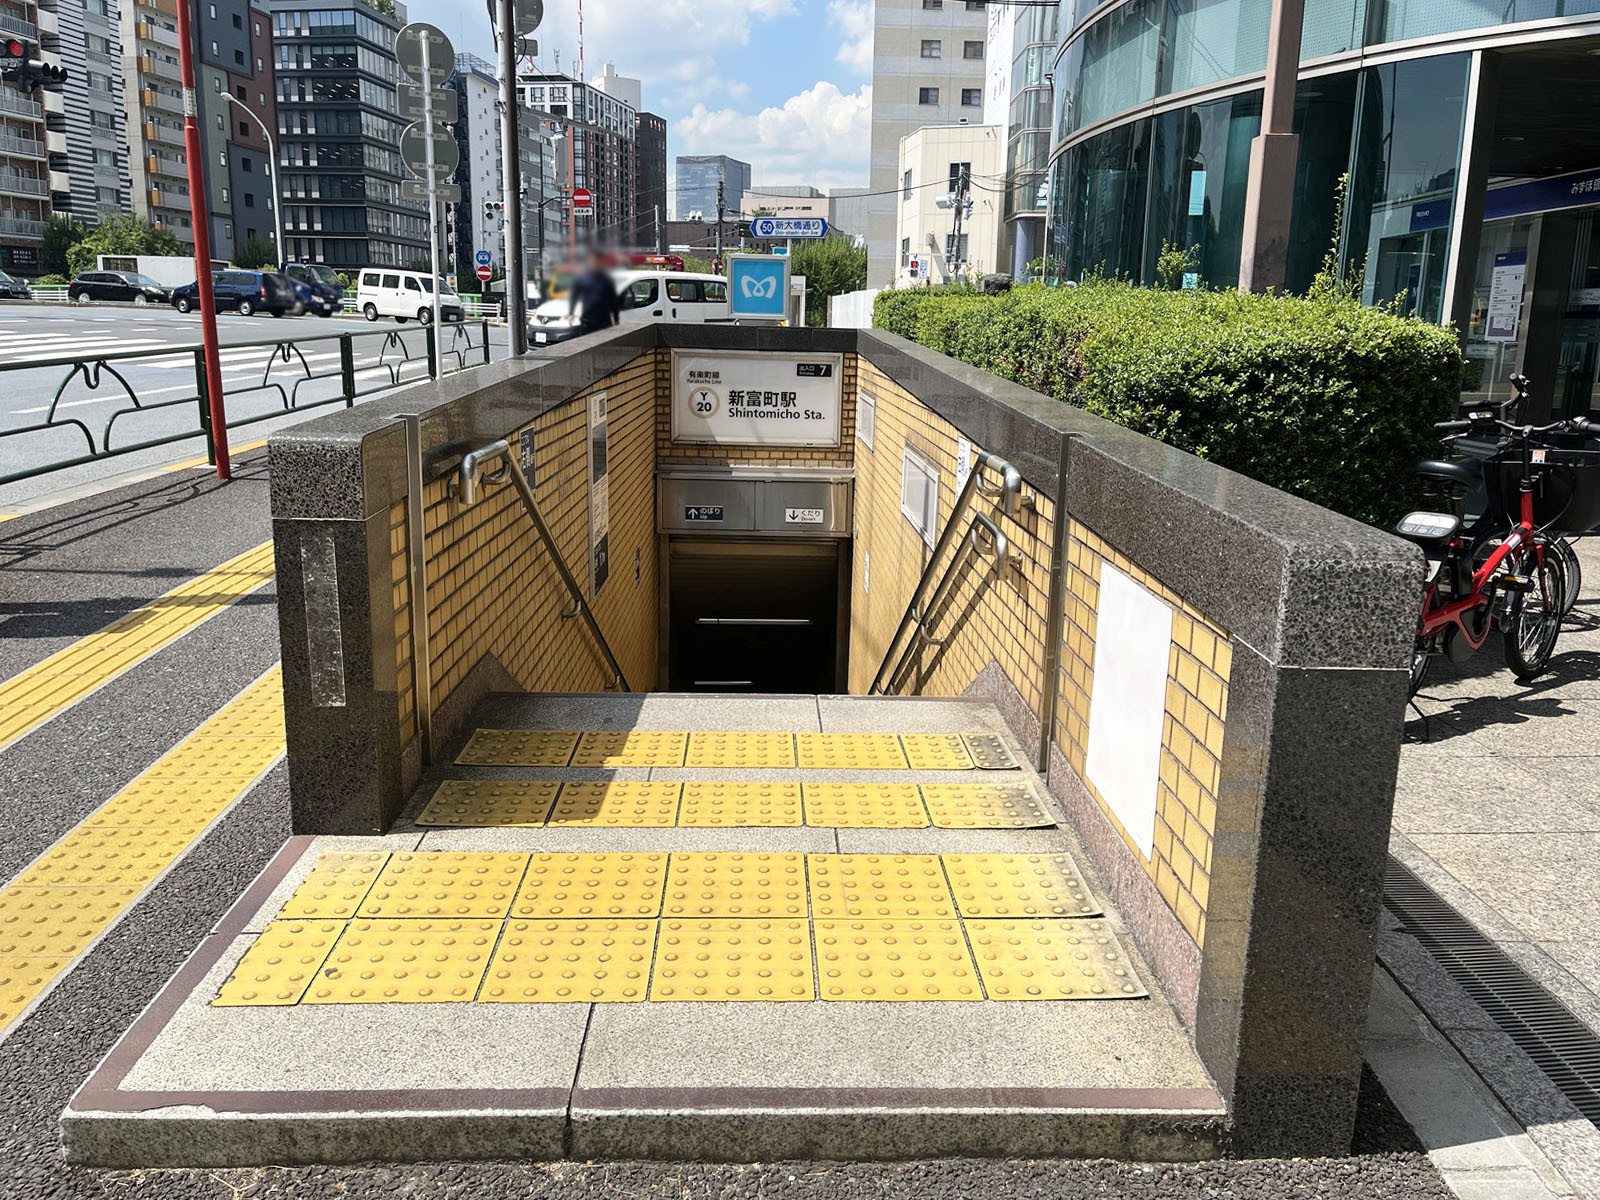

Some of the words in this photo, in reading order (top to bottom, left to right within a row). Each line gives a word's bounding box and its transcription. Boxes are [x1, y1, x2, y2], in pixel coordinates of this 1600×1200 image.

[762, 223, 772, 232] 50
[775, 220, 820, 230] 新大橋通り
[688, 370, 720, 379] 有楽町線
[819, 365, 827, 376] 7
[700, 392, 708, 401] Y
[728, 390, 797, 408] 新富町駅
[696, 402, 712, 412] 20
[728, 407, 801, 420] Shintomicho
[804, 409, 826, 420] Sta.
[699, 507, 721, 515] のぼり
